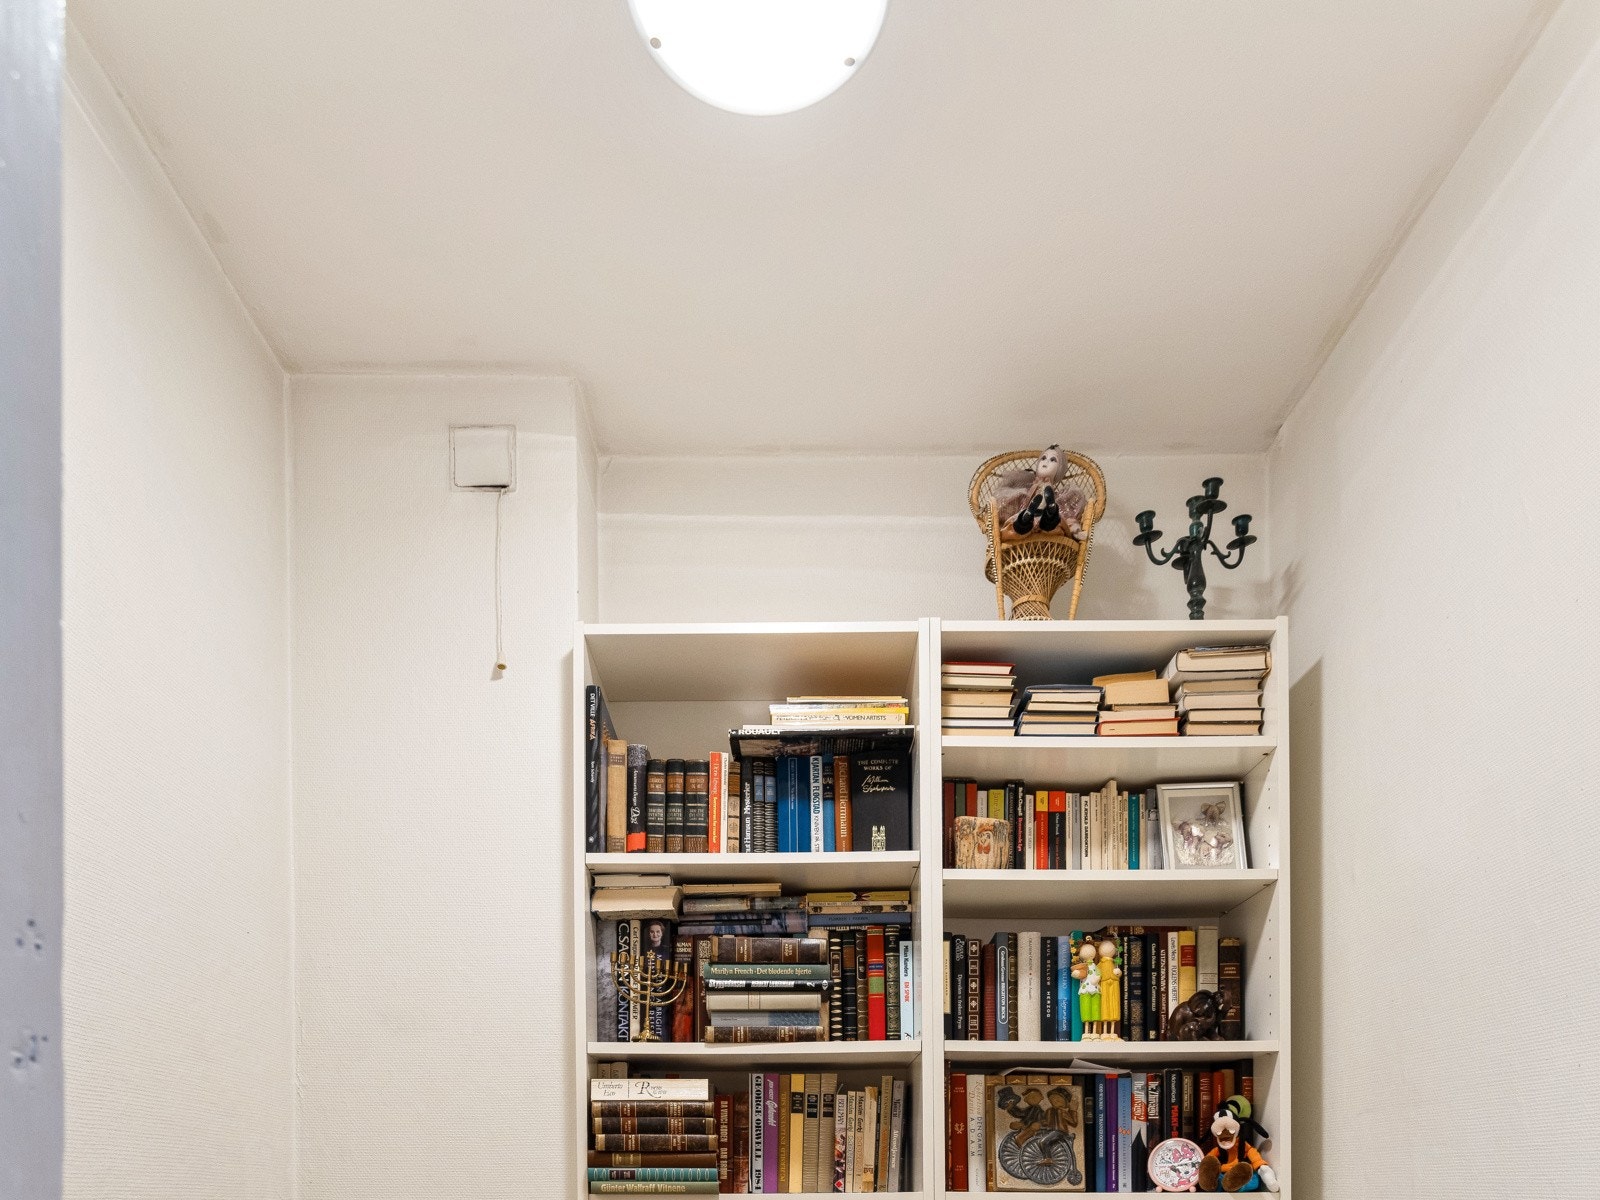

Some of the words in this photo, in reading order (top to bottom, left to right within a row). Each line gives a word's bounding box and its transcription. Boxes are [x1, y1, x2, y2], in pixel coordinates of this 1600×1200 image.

[812, 757, 820, 784] KJARTAN
[839, 762, 848, 795] Richard
[812, 785, 820, 814] FLØGSTAD
[618, 986, 629, 1040] KONTAKT
[754, 1075, 762, 1117] GEORGE
[754, 1118, 762, 1162] ORWELL
[600, 1183, 625, 1193] Günter
[626, 1184, 656, 1193] Wallraff
[657, 1184, 686, 1193] Vitnene
[754, 1168, 762, 1191] 1984
